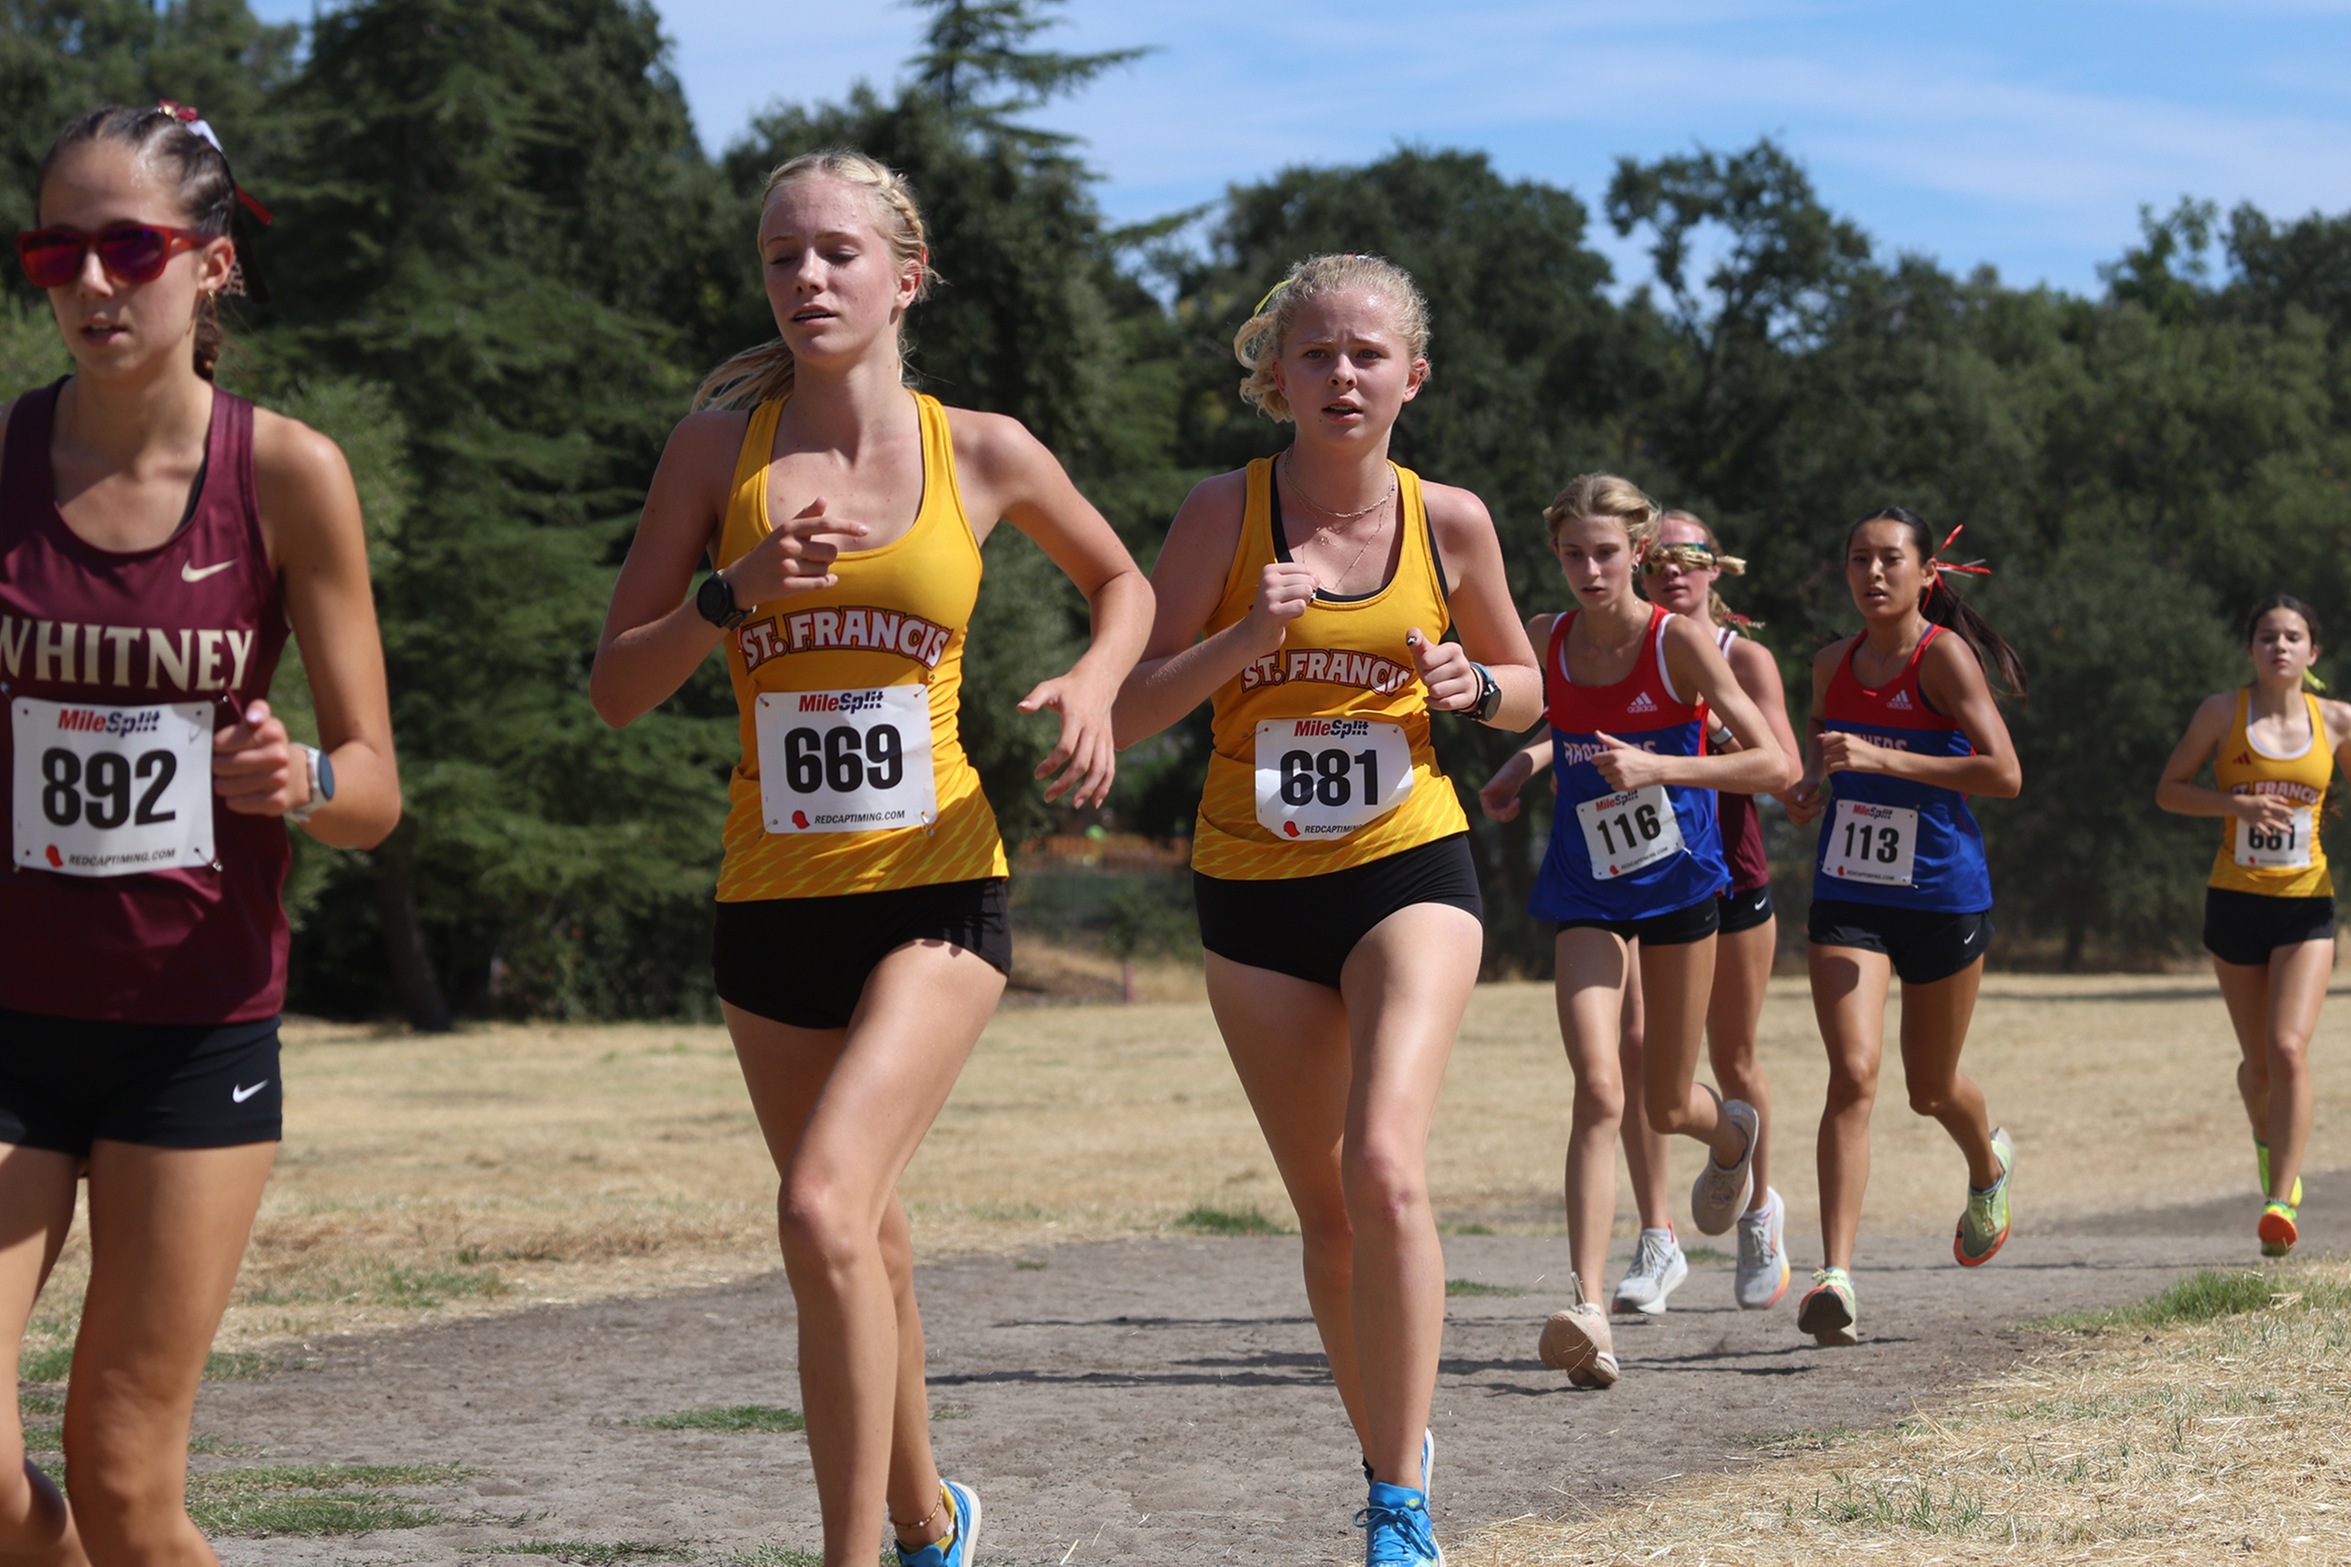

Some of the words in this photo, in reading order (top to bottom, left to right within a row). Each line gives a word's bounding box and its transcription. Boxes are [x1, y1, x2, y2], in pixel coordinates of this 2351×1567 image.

[0, 614, 254, 692] WHITNEY
[738, 618, 788, 673] ST.
[785, 607, 953, 670] FRANCIS
[1242, 651, 1286, 693] ST.
[799, 691, 884, 714] MileSplit
[1627, 703, 1658, 713] adidas
[1886, 701, 1912, 710] adidas
[57, 708, 160, 738] MileSplit
[1294, 719, 1369, 739] MileSplit
[784, 723, 904, 794] 669
[42, 747, 178, 831] 892
[1280, 748, 1379, 807] 681
[1595, 790, 1640, 812] MileSplit
[1852, 803, 1894, 820] MileSplit
[815, 810, 906, 825] REDCAPTIMING.COM
[1597, 803, 1662, 855] 116
[69, 848, 176, 866] REDCAPTIMING.COM
[1844, 822, 1900, 864] 113
